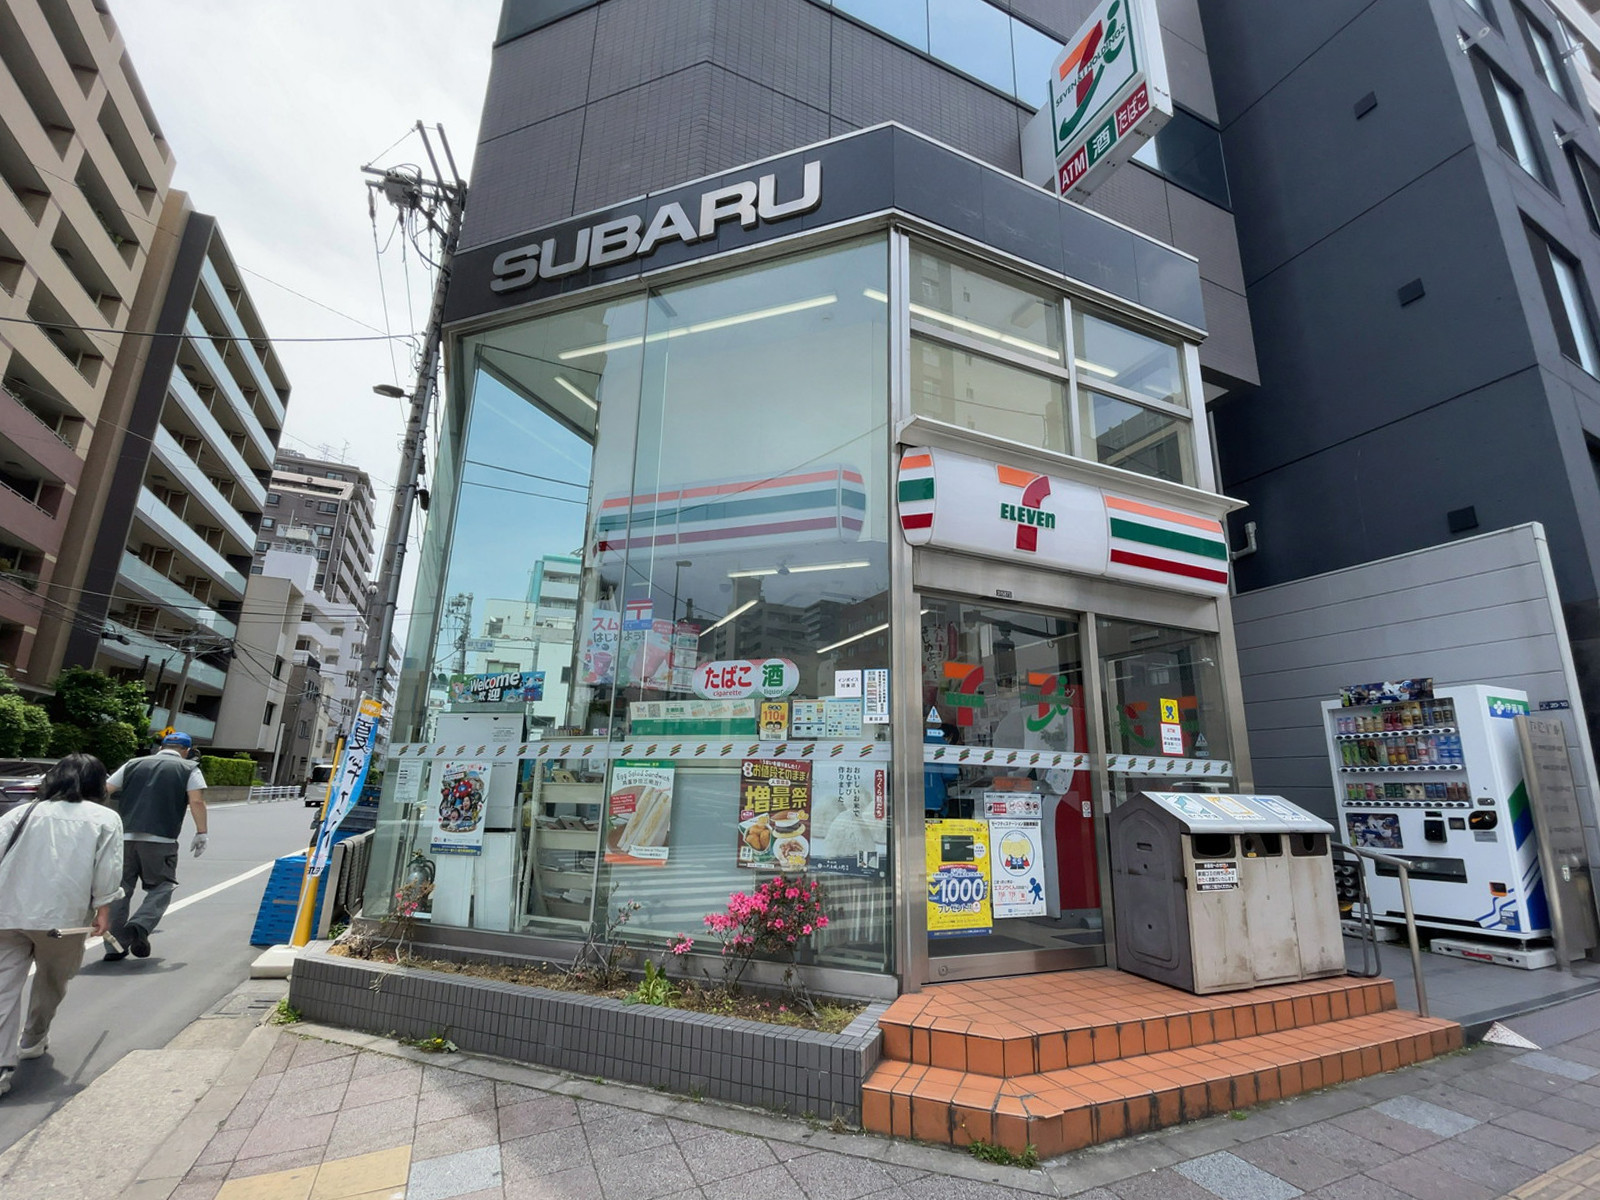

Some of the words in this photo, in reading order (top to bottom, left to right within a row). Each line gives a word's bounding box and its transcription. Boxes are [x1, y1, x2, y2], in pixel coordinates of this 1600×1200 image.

[1061, 154, 1086, 189] ATM
[1093, 125, 1111, 159] 酒
[1117, 90, 1149, 133] たばこ
[490, 160, 822, 294] SUBARU
[470, 671, 521, 692] Welcome
[705, 666, 752, 689] たばこ
[762, 664, 784, 687] 酒
[713, 689, 742, 697] cigarette
[744, 785, 808, 813] 増量祭
[940, 878, 984, 903] 1,000
